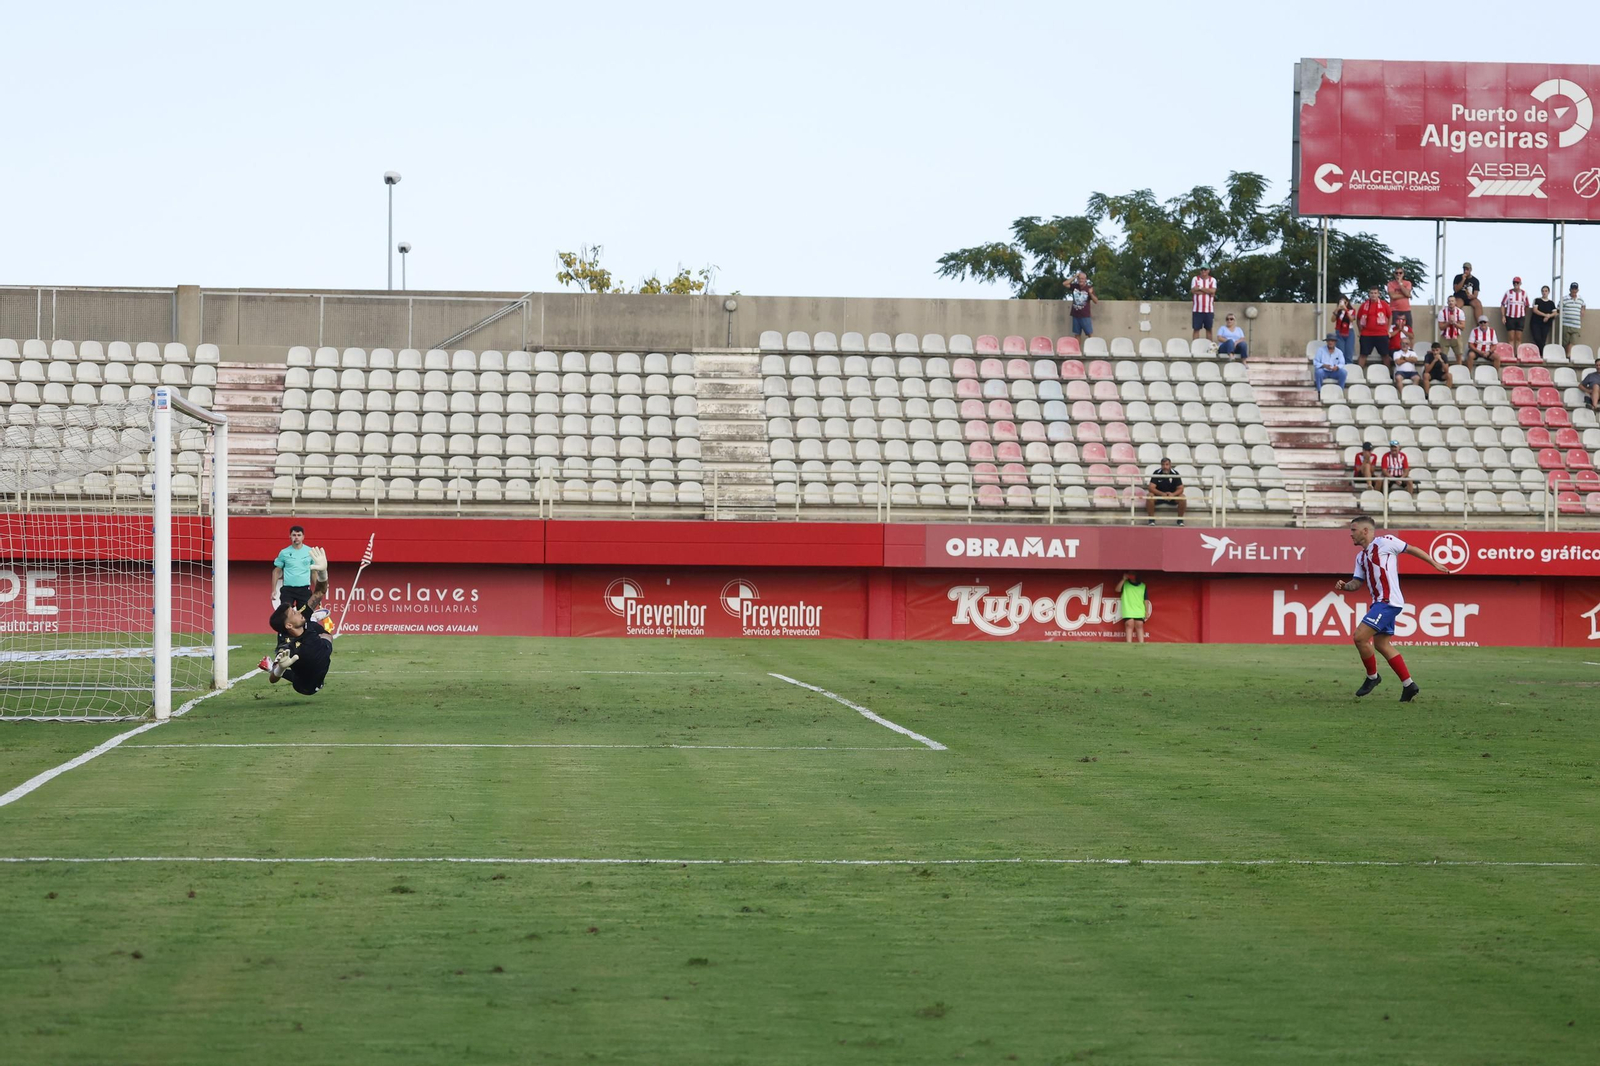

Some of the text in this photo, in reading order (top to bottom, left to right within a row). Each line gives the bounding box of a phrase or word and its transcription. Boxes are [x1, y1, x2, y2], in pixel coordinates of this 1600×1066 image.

[1451, 103, 1549, 123] Puerto de
[1420, 123, 1549, 153] Algeciras
[1349, 169, 1440, 185] ALGECIRAS
[1467, 162, 1546, 177] AESBA
[945, 537, 1080, 558] OBRAMAT
[1228, 542, 1306, 560] HÉLITY
[1477, 545, 1600, 563] centro gráfico
[324, 603, 478, 614] GESTIONES INMOBILIARIAS
[626, 599, 707, 627] Preventor
[742, 600, 823, 627] Preventor
[947, 582, 1152, 637] KubeClu
[0, 619, 59, 632] autocares
[361, 624, 373, 632] DE
[374, 624, 425, 632] EXPERIENCIA
[427, 624, 445, 632] NOS
[446, 624, 479, 632] AVALAN
[626, 626, 655, 635] Servicio
[655, 627, 665, 635] de
[742, 626, 820, 636] Servicio de Prevención
